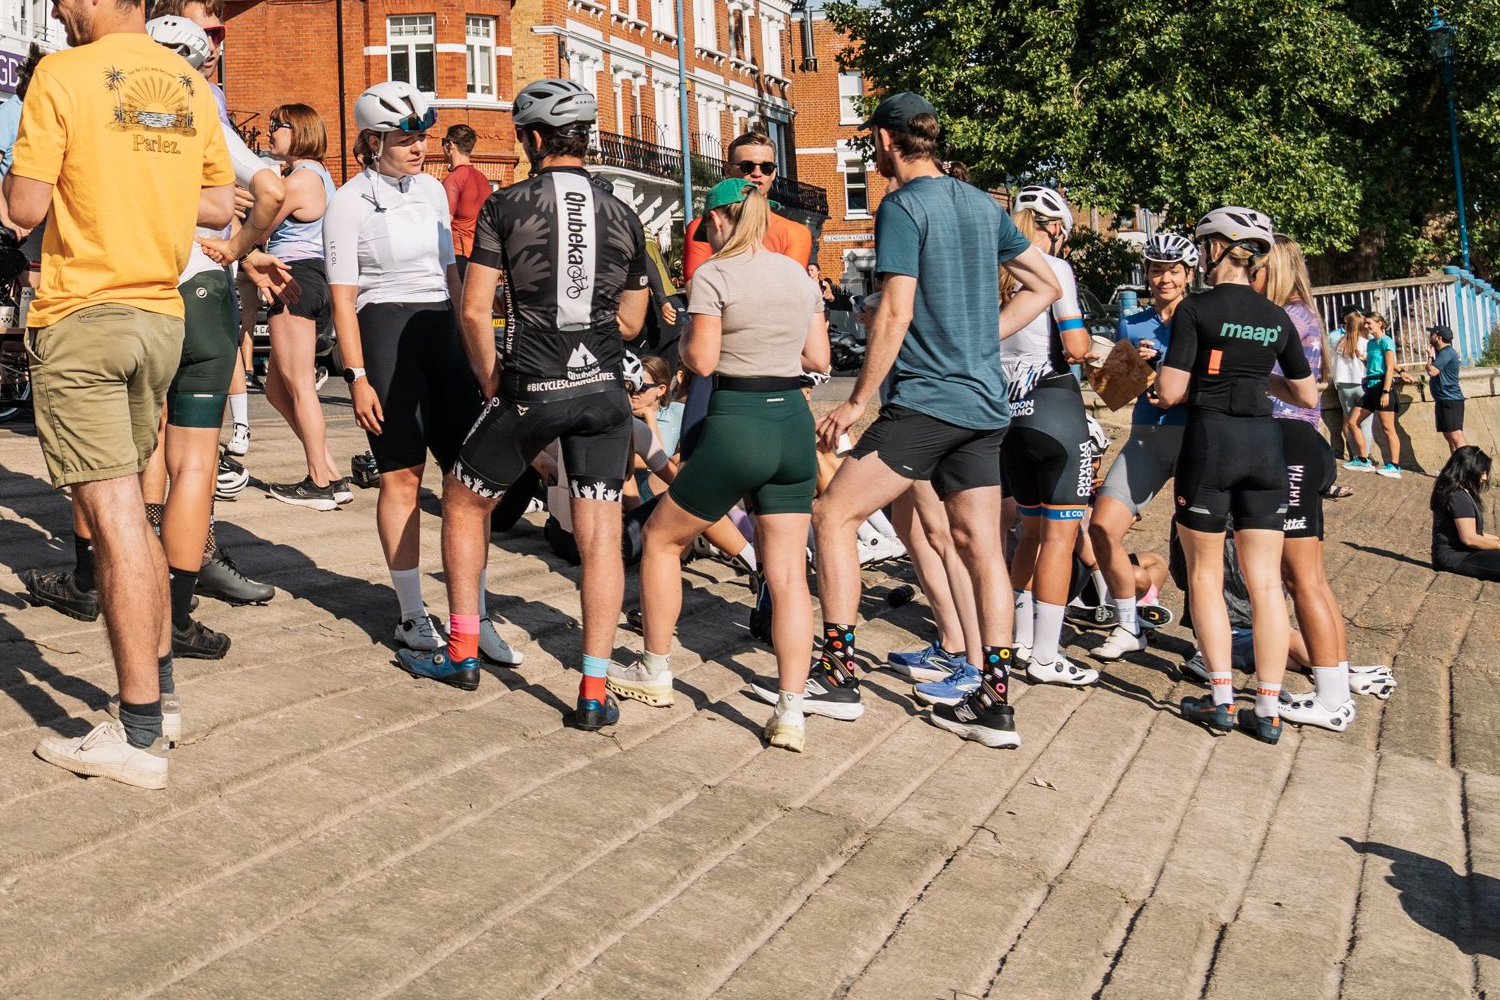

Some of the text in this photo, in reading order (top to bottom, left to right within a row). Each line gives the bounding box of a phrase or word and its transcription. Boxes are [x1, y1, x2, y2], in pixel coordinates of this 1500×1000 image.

[564, 191, 587, 265] Qhubeka
[1077, 442, 1088, 497] DYNAMO
[1083, 440, 1093, 496] LONDON
